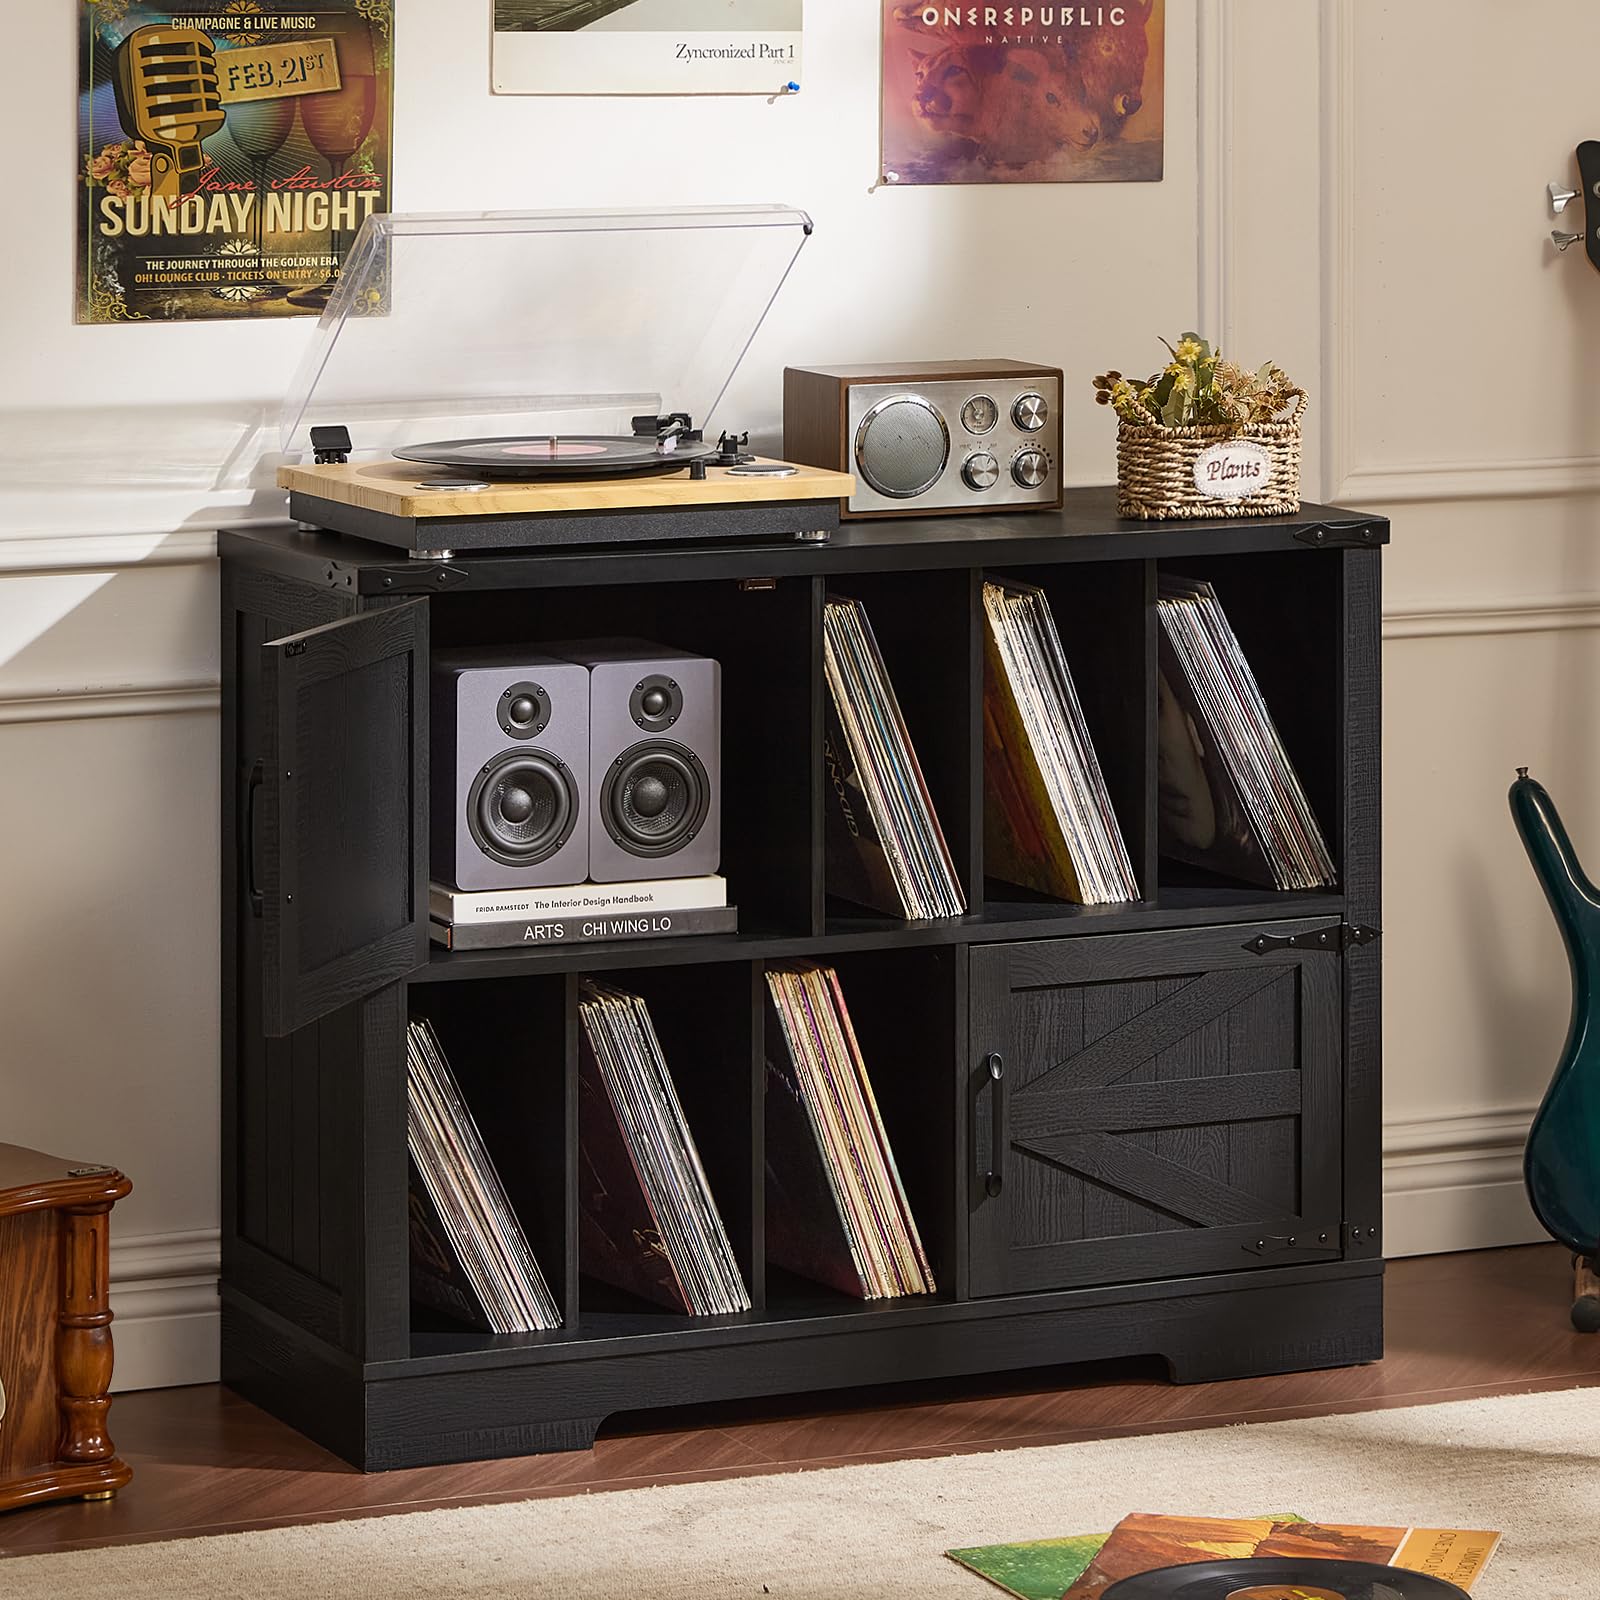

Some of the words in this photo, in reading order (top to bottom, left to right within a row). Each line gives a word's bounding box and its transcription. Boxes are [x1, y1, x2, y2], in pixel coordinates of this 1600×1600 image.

[171, 17, 241, 30] CHAMPAGNE
[243, 17, 252, 29] &
[254, 17, 278, 29] LIVE
[281, 16, 316, 29] MUSIC
[922, 6, 1126, 26] ONEREPUBLIC
[985, 35, 1064, 45] NATIVE
[675, 43, 756, 63] Zyncronized
[759, 43, 784, 58] Part
[788, 44, 795, 58] 1
[169, 165, 258, 209] Jane
[271, 165, 384, 190] Austin
[100, 192, 255, 236] SUNDAY
[267, 190, 381, 232] NIGHT
[146, 261, 165, 271] THE
[166, 259, 211, 270] JOURNEY
[212, 258, 258, 269] THROUGH
[260, 258, 279, 268] THE
[280, 257, 318, 267] GOLDEN
[320, 256, 339, 266] ERA
[135, 273, 153, 283] OH!
[155, 272, 193, 283] LOUNGE
[195, 271, 220, 281] CLUB
[227, 270, 264, 281] TICKETS
[267, 270, 280, 280] ON
[282, 269, 313, 279] ENTRY
[1206, 456, 1261, 481] Plants
[495, 904, 530, 912] RAMSTEDT
[534, 901, 550, 909] The
[551, 899, 582, 909] Interior
[583, 896, 611, 908] Design
[612, 893, 654, 905] Handbook
[524, 924, 564, 940] ARTS
[583, 922, 607, 936] CHI
[610, 919, 649, 934] WING
[652, 917, 671, 932] LO
